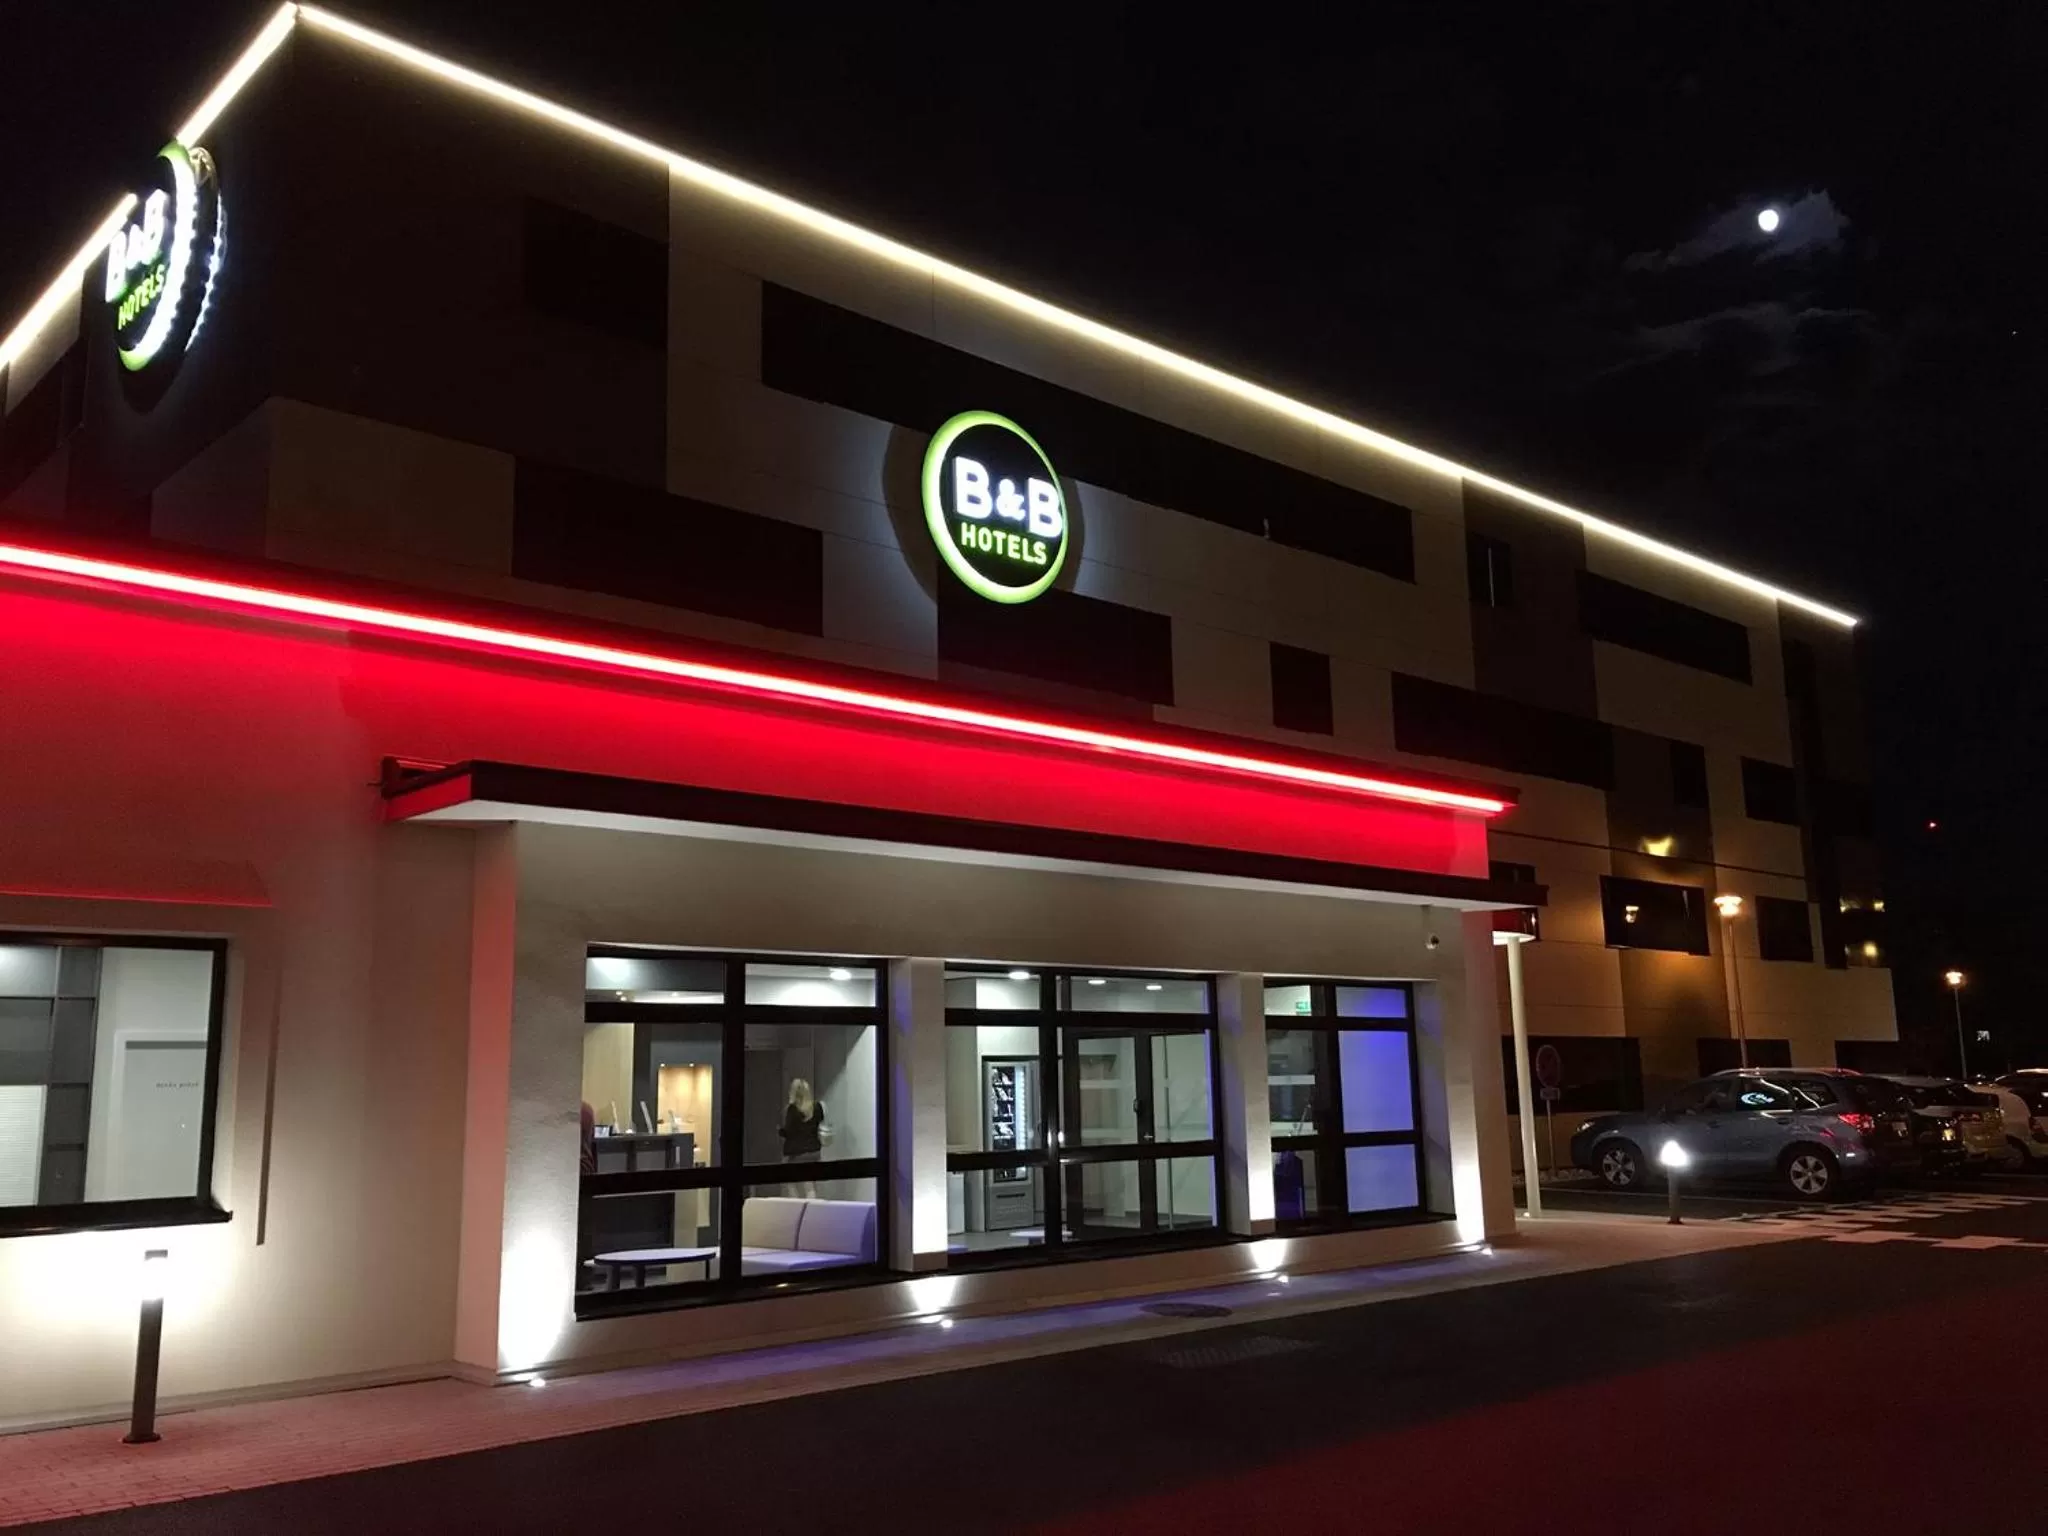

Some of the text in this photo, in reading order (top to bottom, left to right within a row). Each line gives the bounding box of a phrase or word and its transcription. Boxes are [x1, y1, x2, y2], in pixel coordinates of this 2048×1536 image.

[118, 264, 165, 330] HOTELS
[954, 456, 1063, 538] B&B
[961, 522, 1047, 565] HOTELS
